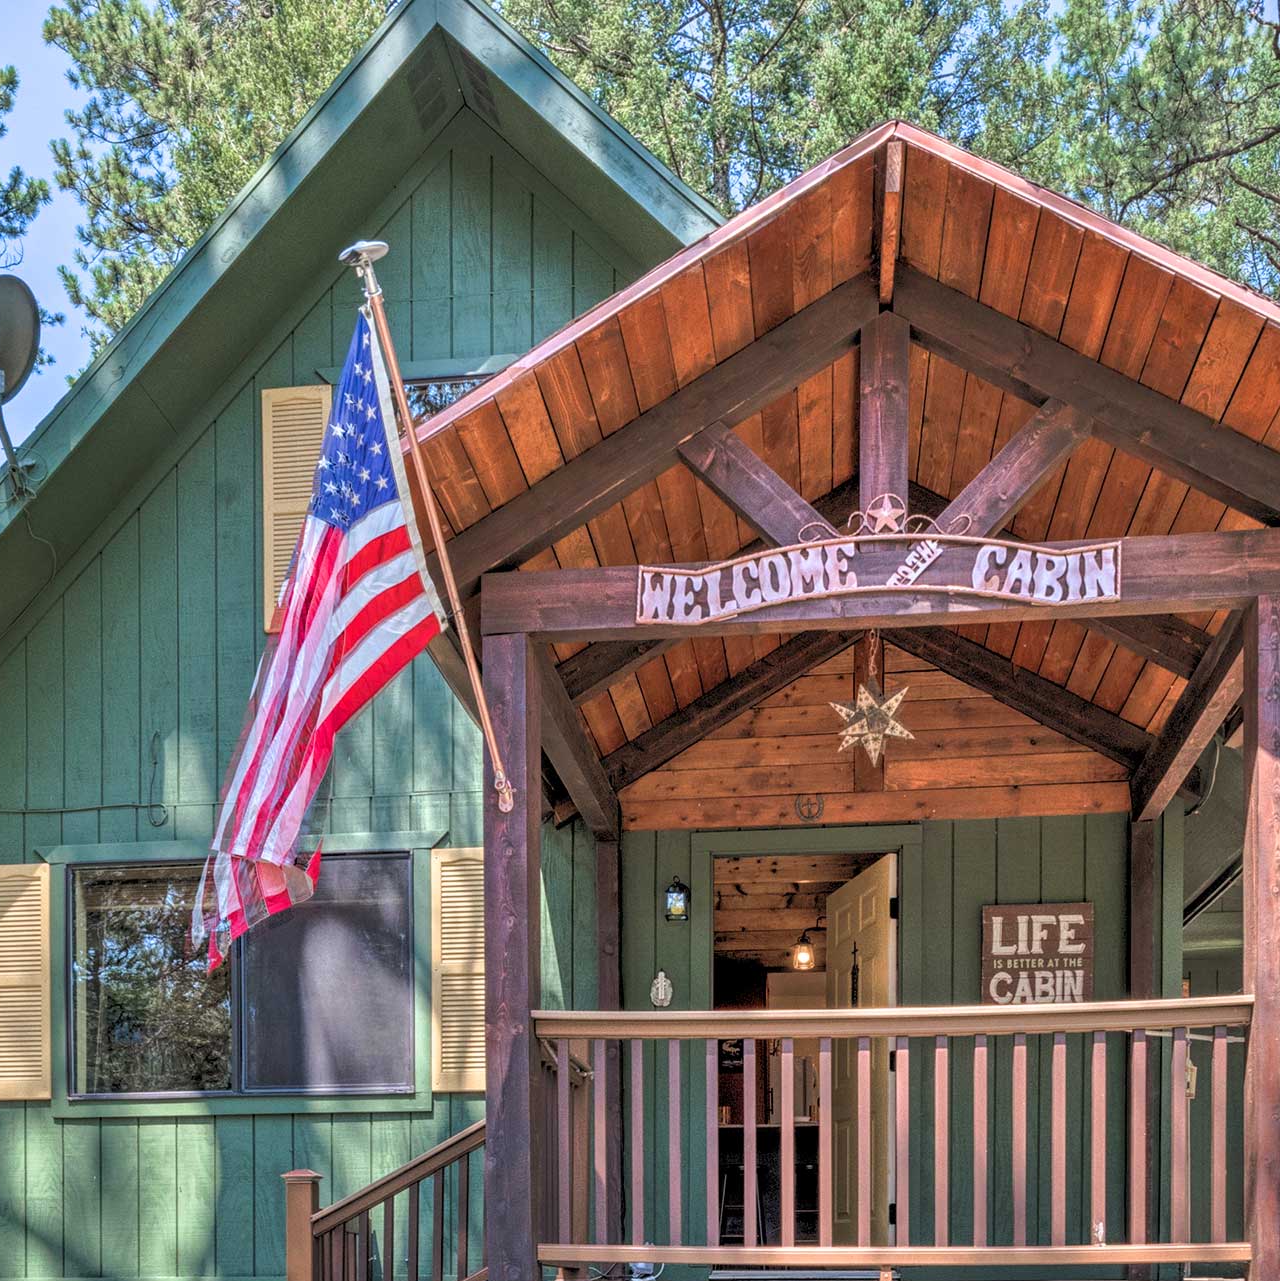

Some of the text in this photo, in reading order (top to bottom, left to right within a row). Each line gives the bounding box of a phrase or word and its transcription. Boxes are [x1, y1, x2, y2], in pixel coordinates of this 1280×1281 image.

[642, 542, 858, 622] WELCOME
[905, 539, 944, 571] THE
[972, 545, 1117, 602] CABIN
[991, 914, 1087, 956] LIFE
[993, 957, 1083, 969] IS BETTER AT THE
[989, 969, 1085, 1005] CABIN
